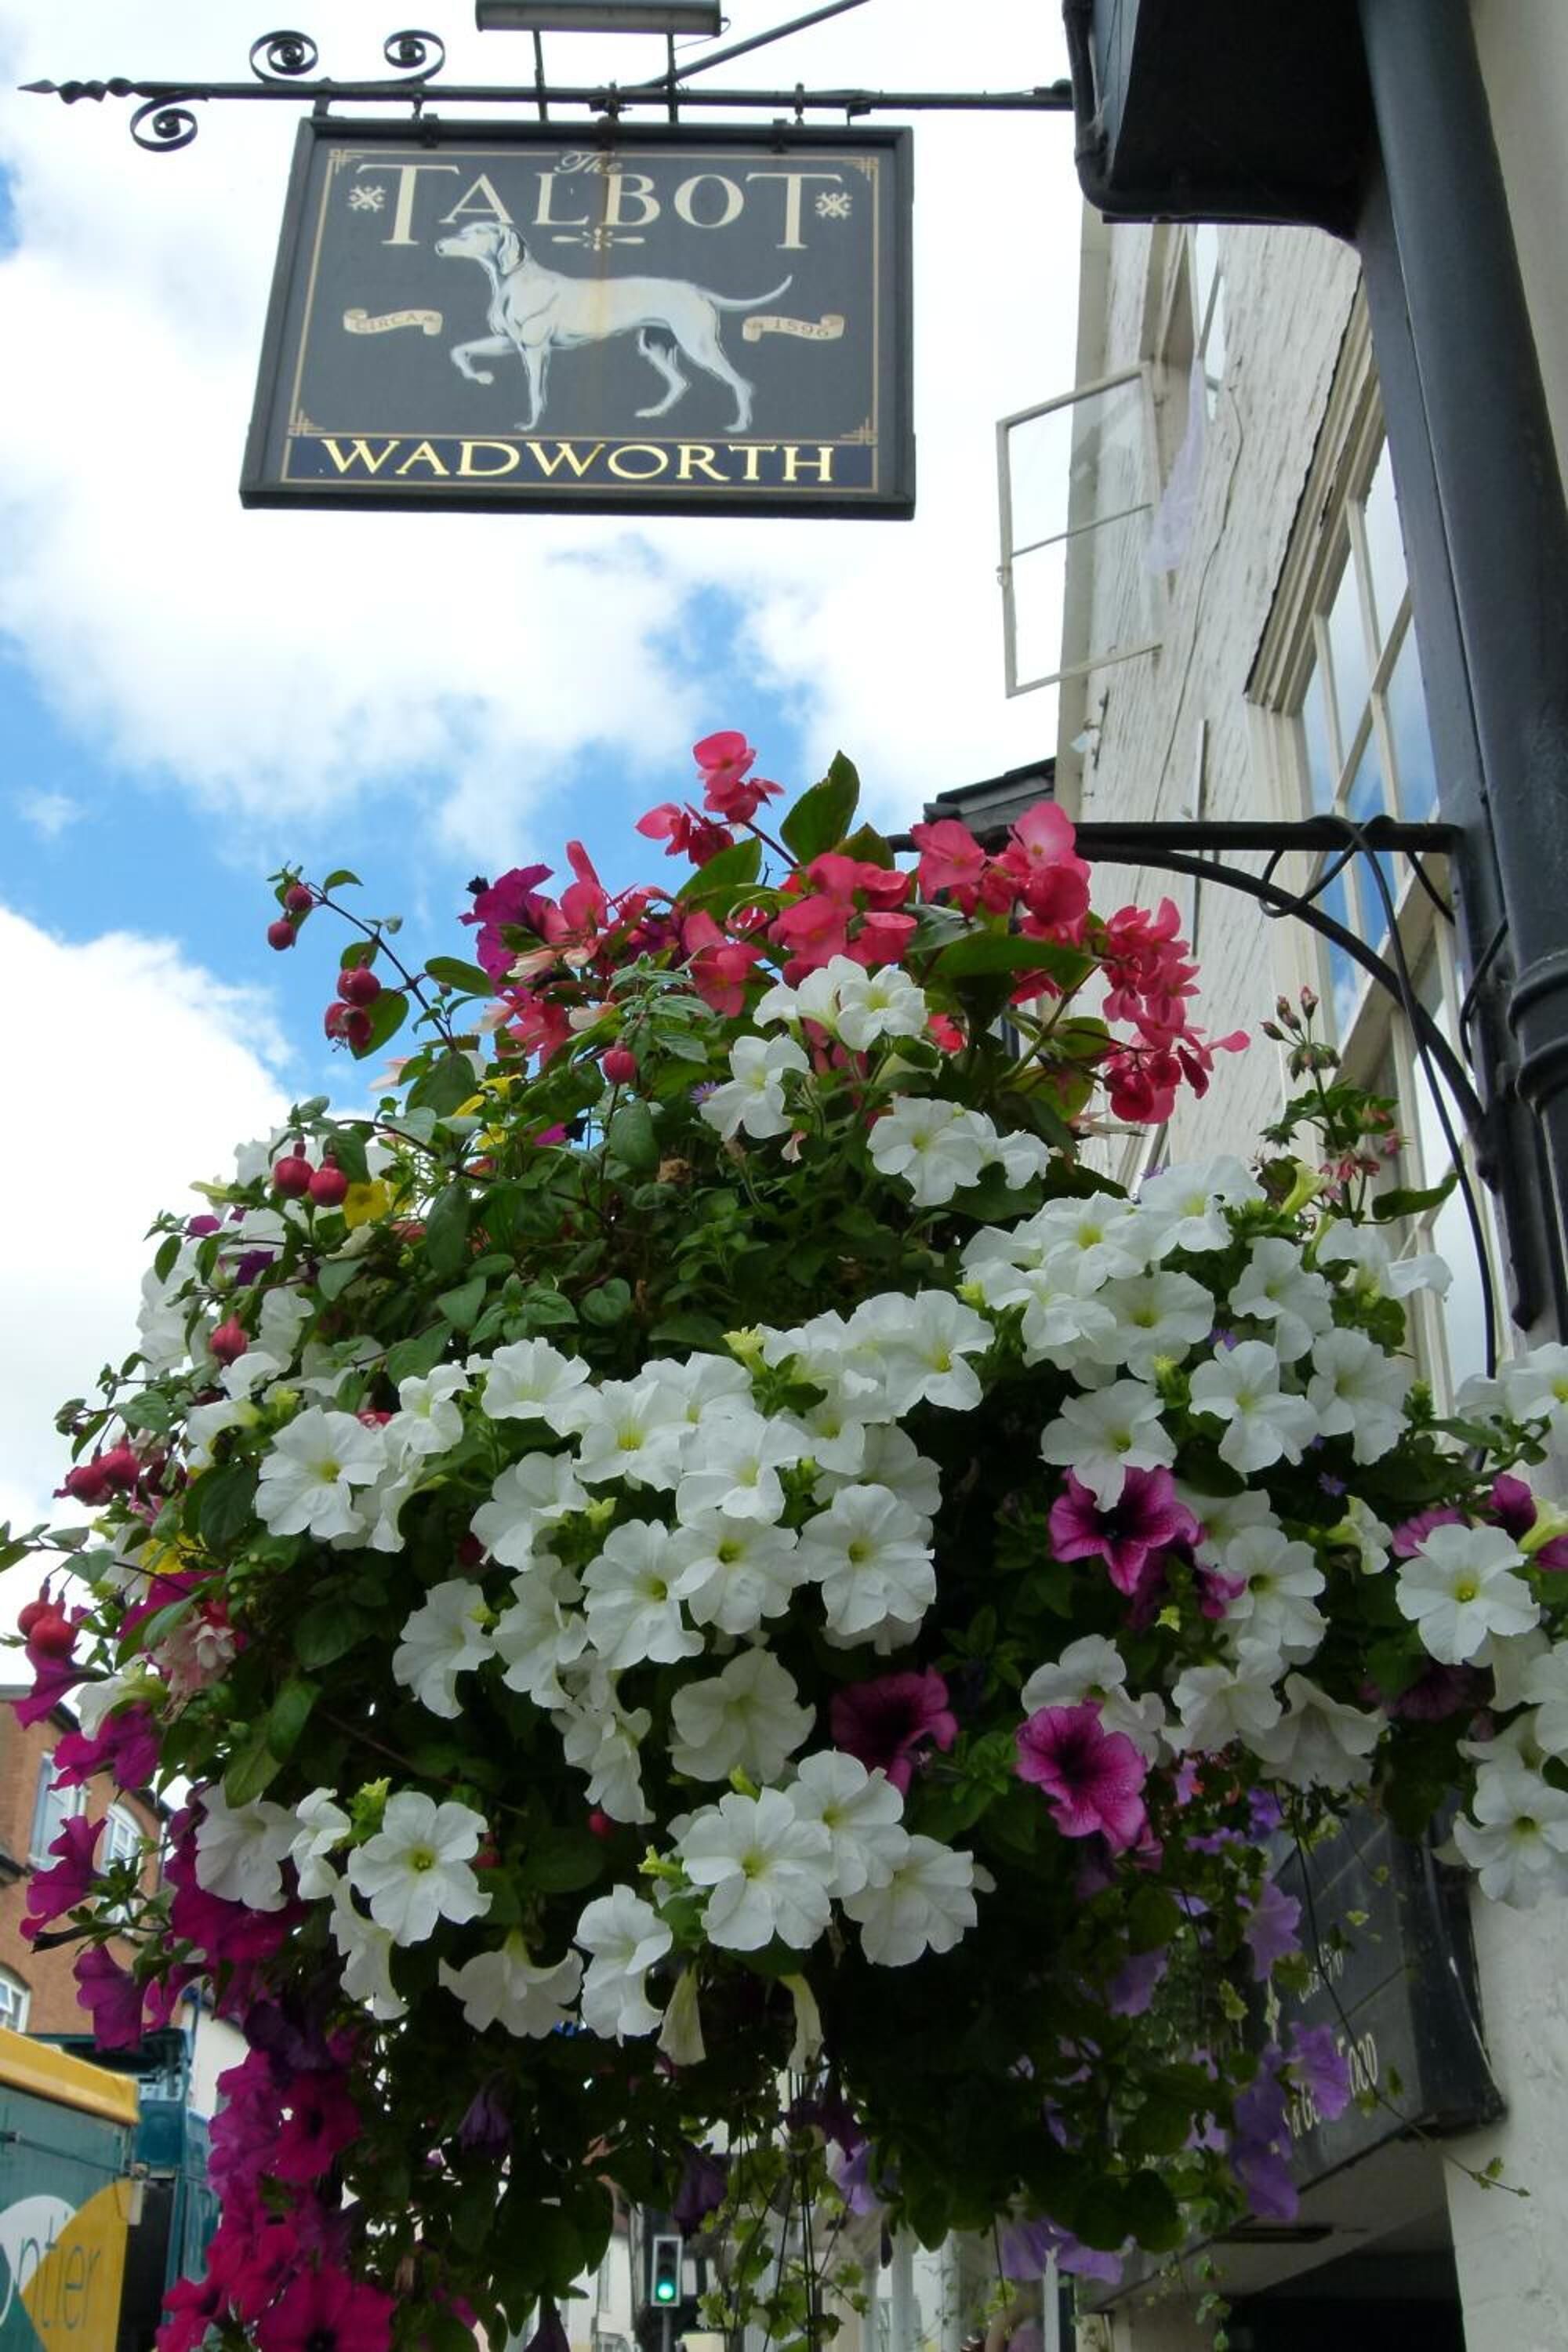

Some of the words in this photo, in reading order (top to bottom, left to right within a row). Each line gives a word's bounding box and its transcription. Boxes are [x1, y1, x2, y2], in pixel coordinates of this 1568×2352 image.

[554, 150, 623, 173] The
[356, 163, 843, 249] TALBOT
[355, 313, 419, 330] CIRCA
[320, 438, 833, 482] WADWORTH
[0, 2210, 102, 2329] ntier
